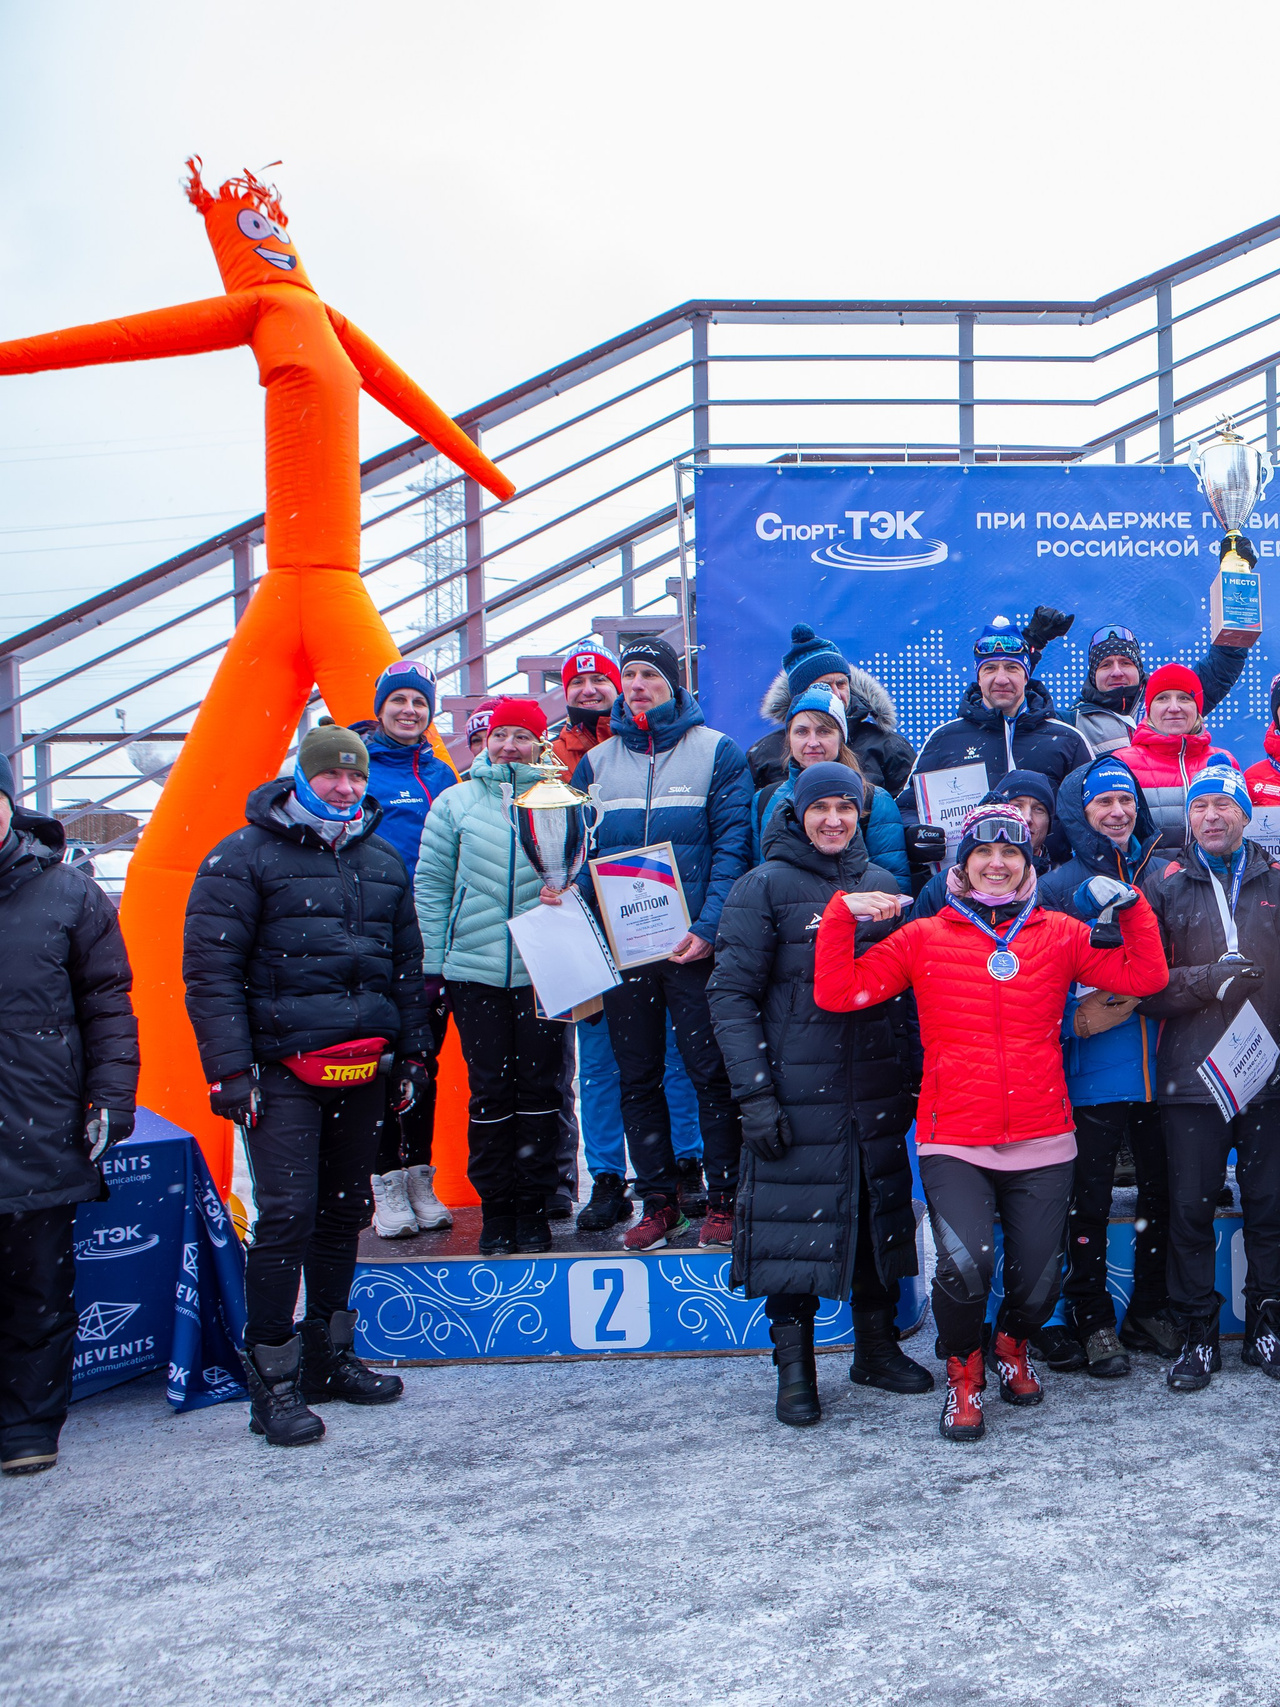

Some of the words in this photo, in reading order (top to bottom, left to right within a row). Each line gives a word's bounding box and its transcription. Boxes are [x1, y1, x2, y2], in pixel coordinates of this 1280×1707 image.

[976, 511, 1028, 530] ПРИ
[1035, 511, 1193, 531] ПОДДЕРЖКЕ
[1037, 535, 1199, 558] РОССИЙСКОЙ
[1229, 578, 1257, 587] МЕСТО
[620, 895, 669, 919] ДИПЛОМ
[1232, 1033, 1263, 1078] ДИПЛОМ
[1246, 1050, 1263, 1071] место
[321, 1061, 378, 1082] START
[593, 1268, 627, 1342] 2
[72, 1335, 155, 1371] NEVENTS
[86, 1352, 155, 1376] communications
